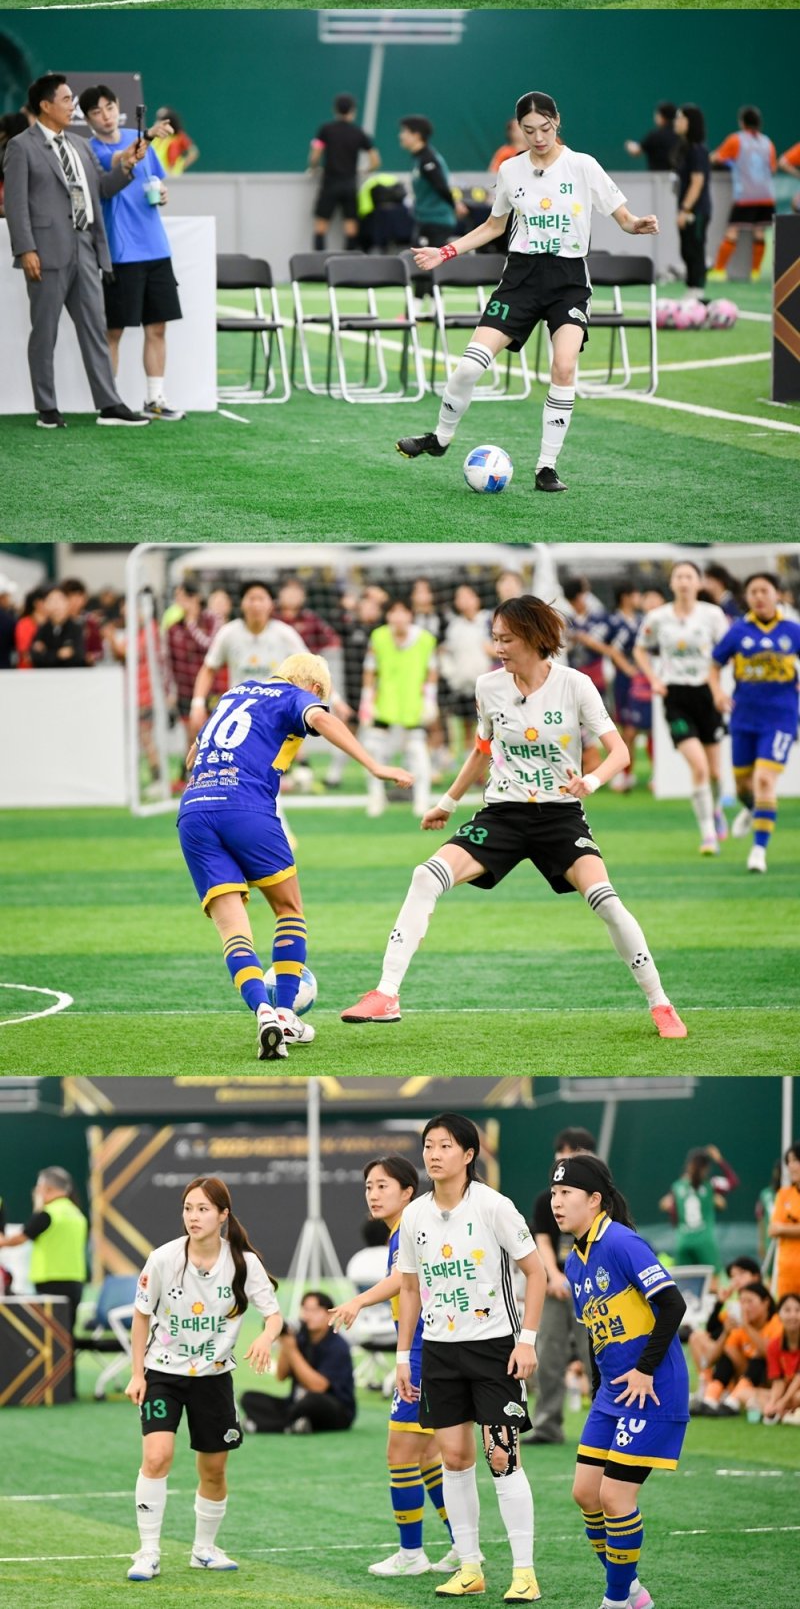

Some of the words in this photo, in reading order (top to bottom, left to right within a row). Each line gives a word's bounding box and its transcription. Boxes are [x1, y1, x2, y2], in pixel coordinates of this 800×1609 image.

[559, 183, 573, 195] 31
[486, 300, 510, 321] 31
[199, 698, 259, 751] 16
[543, 711, 563, 725] 33
[514, 767, 554, 791] 그녀들
[456, 824, 489, 845] 33
[466, 1222, 473, 1236] 1
[422, 1259, 477, 1287] 골때리는
[216, 1286, 232, 1299] 13
[434, 1287, 470, 1312] 그녀들
[170, 1314, 228, 1337] 골때리는
[177, 1339, 217, 1362] 그녀들
[143, 1398, 167, 1421] 13
